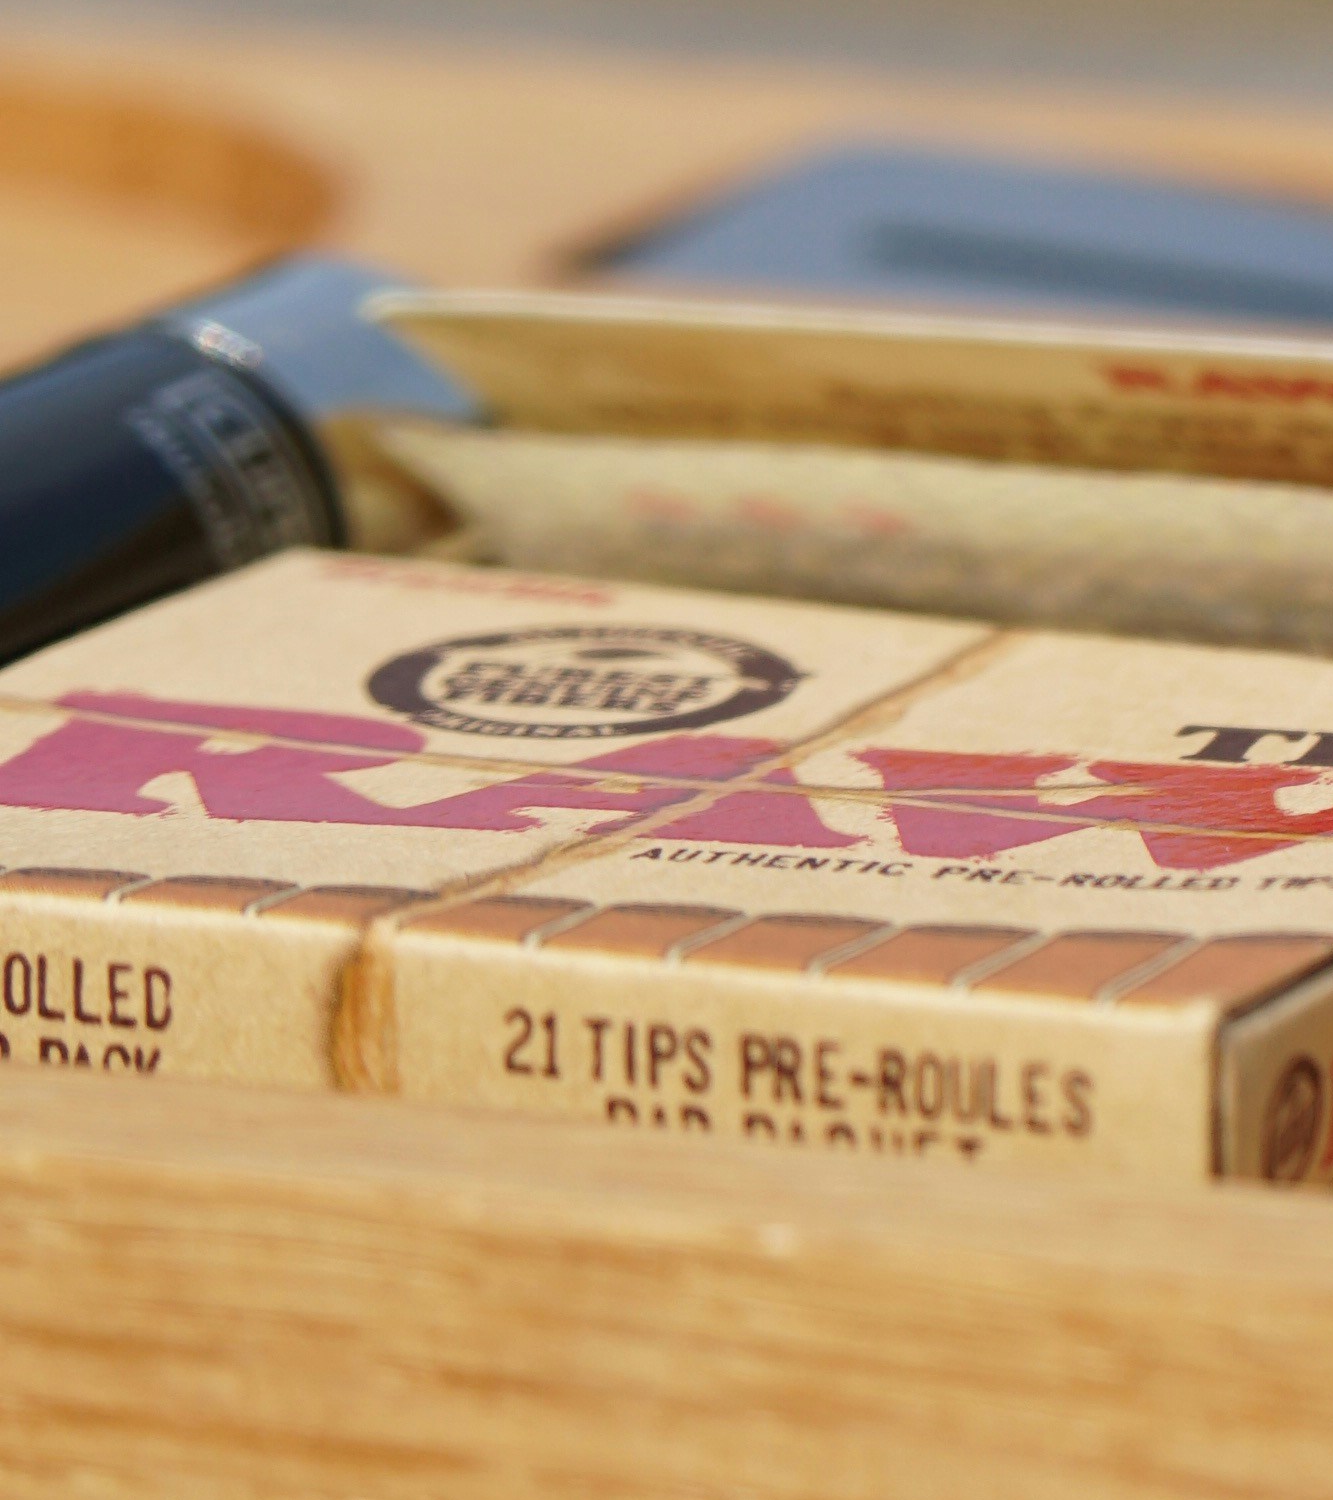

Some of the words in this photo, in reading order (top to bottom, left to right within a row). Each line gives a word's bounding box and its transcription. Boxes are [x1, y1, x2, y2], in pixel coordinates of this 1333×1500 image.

[629, 847, 913, 878] AUTHENTIC
[930, 864, 1242, 891] PRE-ROLLED
[3, 952, 173, 1032] OLLED
[502, 1008, 561, 1080] 21
[583, 1017, 714, 1095] TIPS
[736, 1032, 1095, 1139] PRE-ROULES
